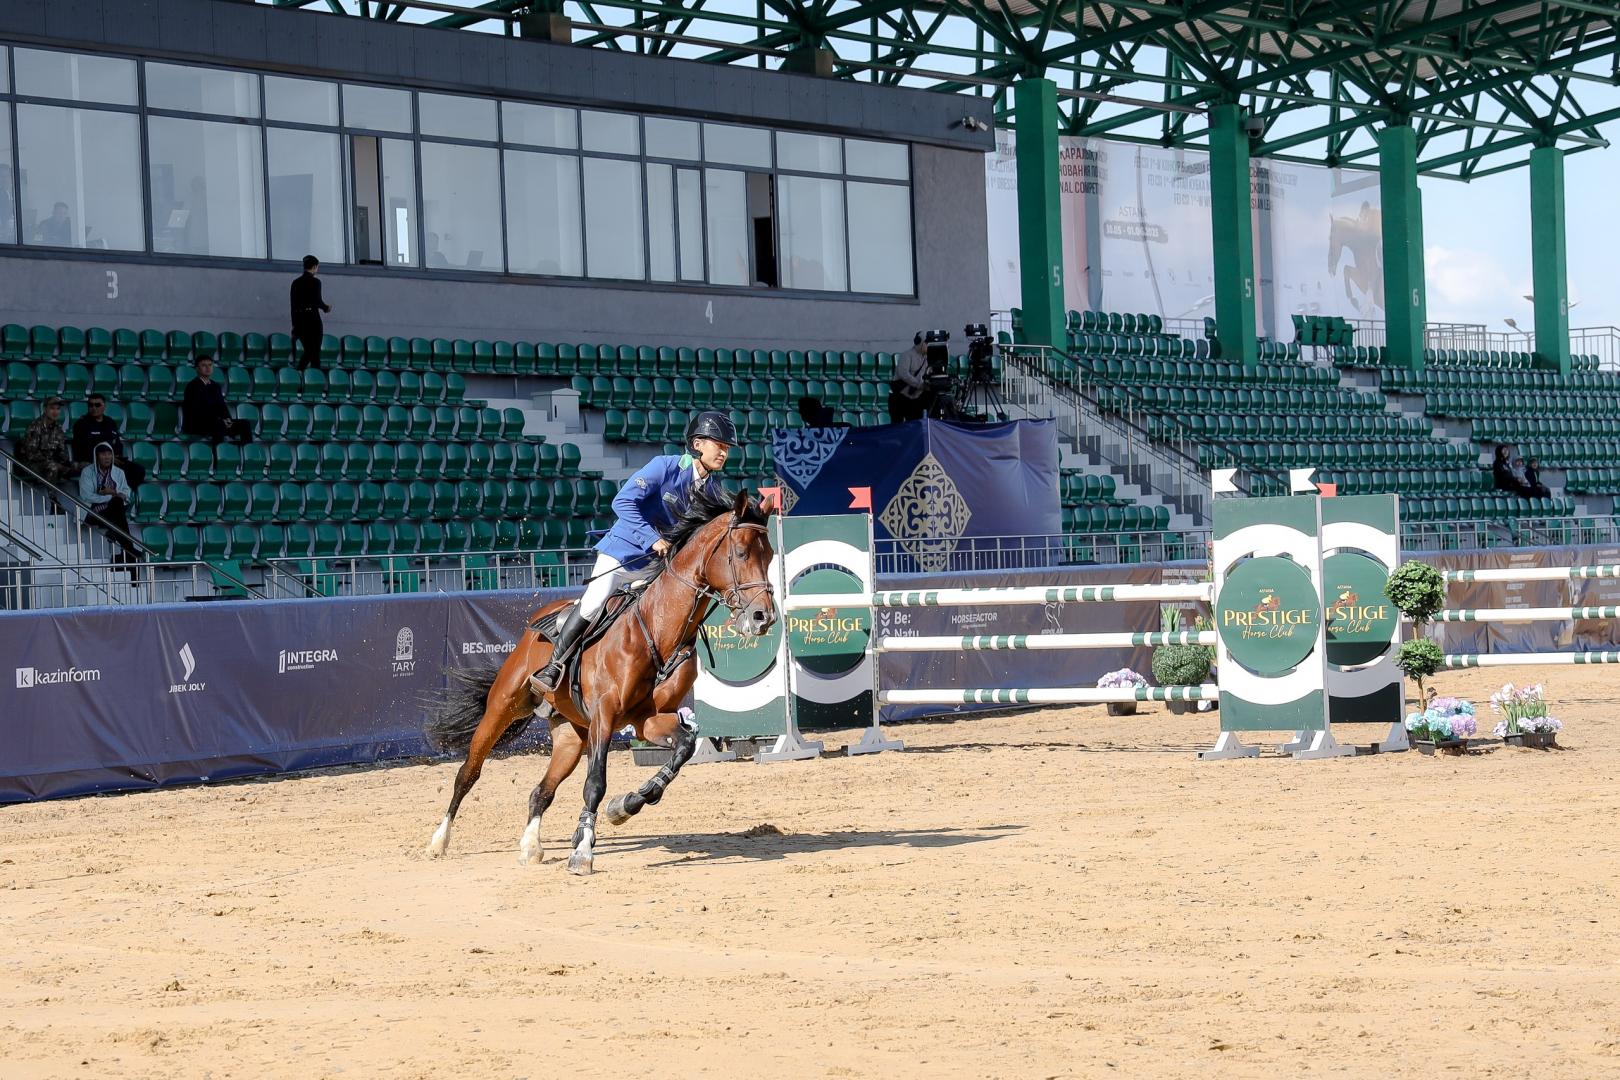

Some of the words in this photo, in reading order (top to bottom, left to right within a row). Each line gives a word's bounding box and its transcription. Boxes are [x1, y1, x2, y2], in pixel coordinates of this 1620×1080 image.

[1053, 265, 1061, 287] 5
[105, 270, 119, 299] 3
[1245, 278, 1252, 298] 5
[1412, 288, 1420, 307] 6
[705, 300, 714, 324] 4
[1560, 298, 1567, 316] 6
[894, 611, 911, 625] Be:
[951, 612, 998, 625] HORSEFACTOR
[1224, 609, 1312, 626] PRESTIGE
[1325, 605, 1389, 621] ESTIGE
[698, 624, 774, 640] PRESE
[790, 618, 864, 633] PRESTIGE
[1242, 625, 1268, 639] Horse
[1269, 624, 1296, 638] Club
[1347, 620, 1373, 633] Club
[713, 638, 736, 651] Horse
[804, 632, 826, 645] Horse
[828, 631, 849, 643] Club
[287, 649, 338, 664] INTEGRA
[391, 661, 416, 672] TARY
[34, 666, 101, 685] kazinform
[188, 682, 206, 692] JOLY
